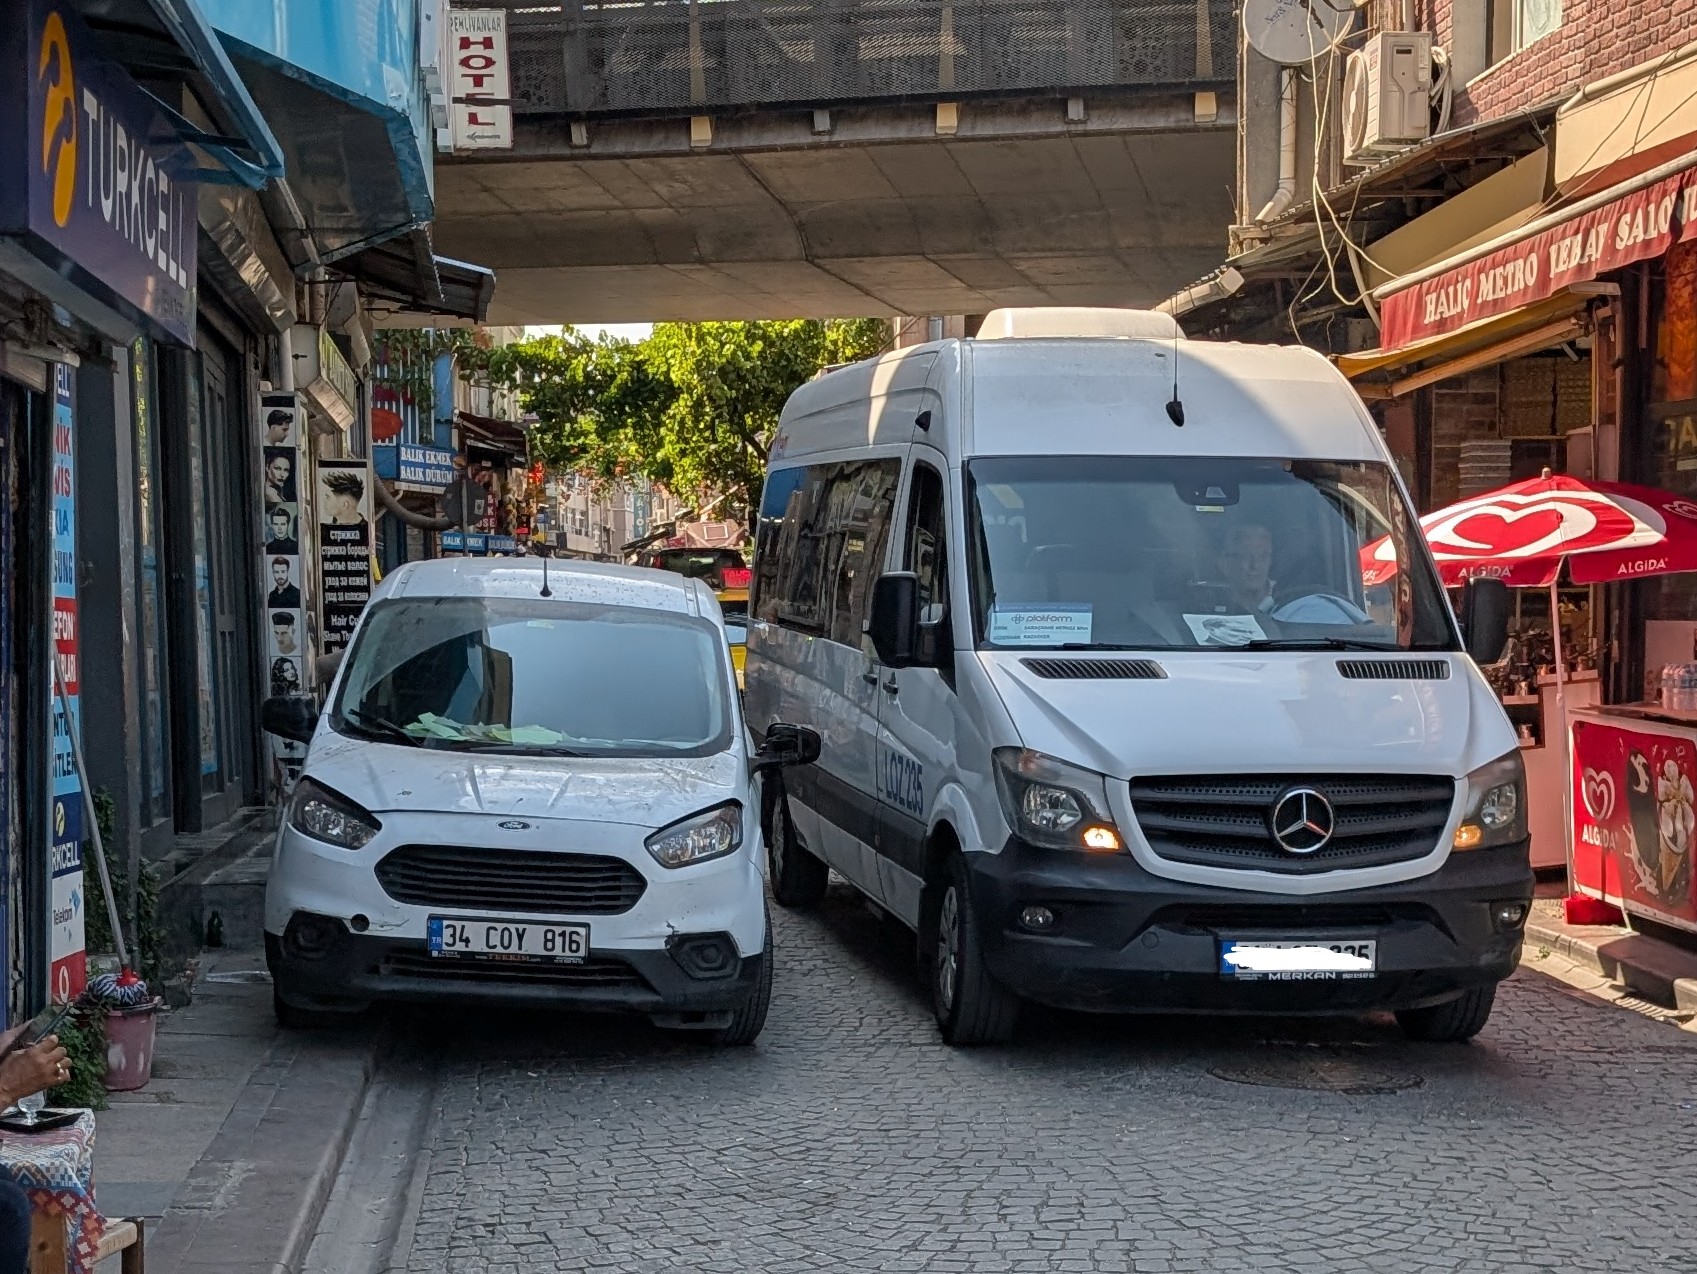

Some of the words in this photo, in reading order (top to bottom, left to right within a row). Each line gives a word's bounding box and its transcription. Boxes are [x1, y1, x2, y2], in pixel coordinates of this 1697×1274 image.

[83, 87, 188, 290] TURKCELL
[1424, 276, 1471, 324] HALİÇ
[1476, 252, 1538, 304] METRO
[401, 447, 424, 463] BALIK
[426, 451, 451, 466] EKMEK
[401, 466, 424, 481] BALIK
[426, 467, 453, 483] DÜRÜM
[1458, 565, 1511, 578] ALGIDA
[1617, 559, 1667, 575] ALGIDA
[331, 615, 347, 626] Hair
[1025, 614, 1073, 623] platform
[1581, 823, 1615, 851] ALGIDA
[444, 923, 471, 949] 34
[486, 926, 528, 951] COY
[543, 928, 581, 954] 816
[1268, 972, 1336, 980] MERKAN
